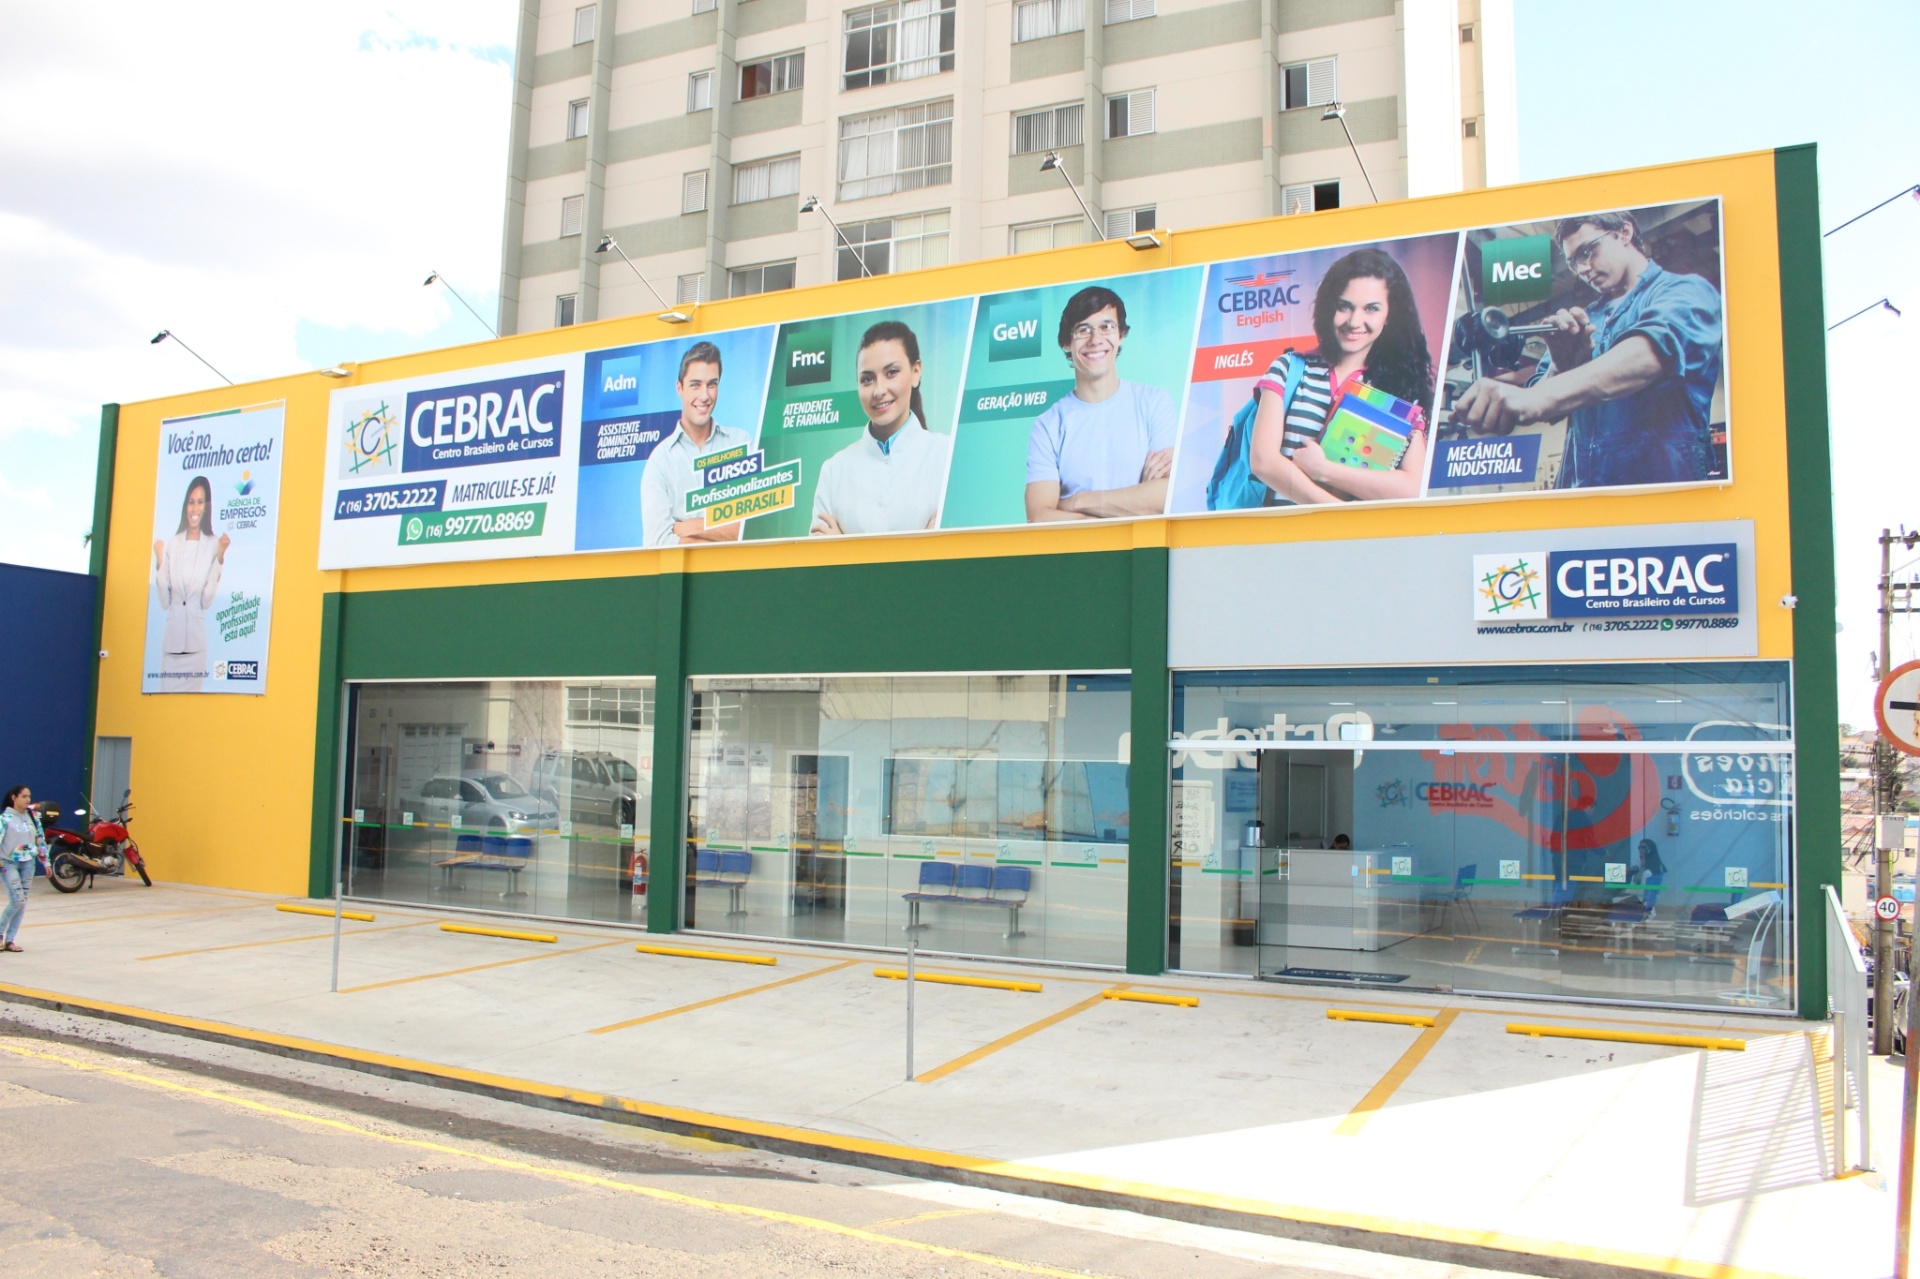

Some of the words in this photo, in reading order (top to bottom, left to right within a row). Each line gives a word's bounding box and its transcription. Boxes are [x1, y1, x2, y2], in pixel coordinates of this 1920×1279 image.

[1492, 261, 1542, 282] Mec
[1218, 284, 1301, 314] CEBRAC
[1236, 311, 1284, 328] English
[993, 319, 1038, 342] GeW
[792, 350, 825, 367] Fmc
[1214, 352, 1253, 369] INGLÊS
[604, 374, 637, 392] Adm
[783, 399, 833, 416] ATENDENTE
[977, 392, 1022, 412] GERAÇÃO
[1024, 391, 1047, 405] WEB
[410, 384, 555, 447] CEBRAC
[783, 417, 794, 428] DE
[797, 410, 839, 427] FARMÁCIA
[598, 421, 640, 436] ASSISTENTE
[168, 430, 194, 454] Você
[433, 446, 461, 459] Centro
[464, 443, 504, 457] Brasileiro
[507, 440, 518, 451] de
[521, 437, 553, 450] Cursos
[598, 431, 660, 448] ADMINISTRATIVO
[182, 444, 234, 470] caminho
[236, 438, 273, 464] certo!
[597, 445, 636, 459] COMPLETO
[697, 458, 706, 468] OS
[707, 448, 743, 466] MELHORES
[1447, 441, 1513, 461] MECÂNICA
[708, 457, 757, 484] CURSOS
[1448, 458, 1522, 477] INDUSTRIAL
[452, 477, 536, 503] MATRICULE-SE
[537, 471, 556, 497] JÁ!
[691, 469, 793, 508] Profissionalizantes
[252, 496, 261, 505] DE
[347, 499, 362, 514] (16)
[364, 487, 437, 511] 3705.2222
[220, 505, 266, 520] EMPREGOS
[713, 501, 733, 522] DO
[236, 520, 258, 529] CEBRAC
[426, 525, 442, 538] (16)
[445, 510, 535, 536] 99770.8869
[1557, 554, 1724, 598] CEBRAC
[231, 591, 243, 604] Sua
[1586, 599, 1620, 609] Centro
[1623, 597, 1670, 608] Brasileiro
[1673, 596, 1686, 606] de
[1689, 596, 1725, 606] Cursos
[216, 596, 261, 622] oportunidade
[220, 607, 258, 634] profissional
[1477, 622, 1574, 635] www.cebrac.com.br
[1589, 622, 1602, 632] (16)
[1604, 620, 1658, 632] 3705.2222
[1676, 618, 1738, 630] 99770.8869
[225, 627, 239, 642] está
[239, 623, 256, 639] aqui!
[228, 664, 256, 674] CEBRAC
[1415, 782, 1493, 802] CEBRAC
[1879, 902, 1897, 914] 40
